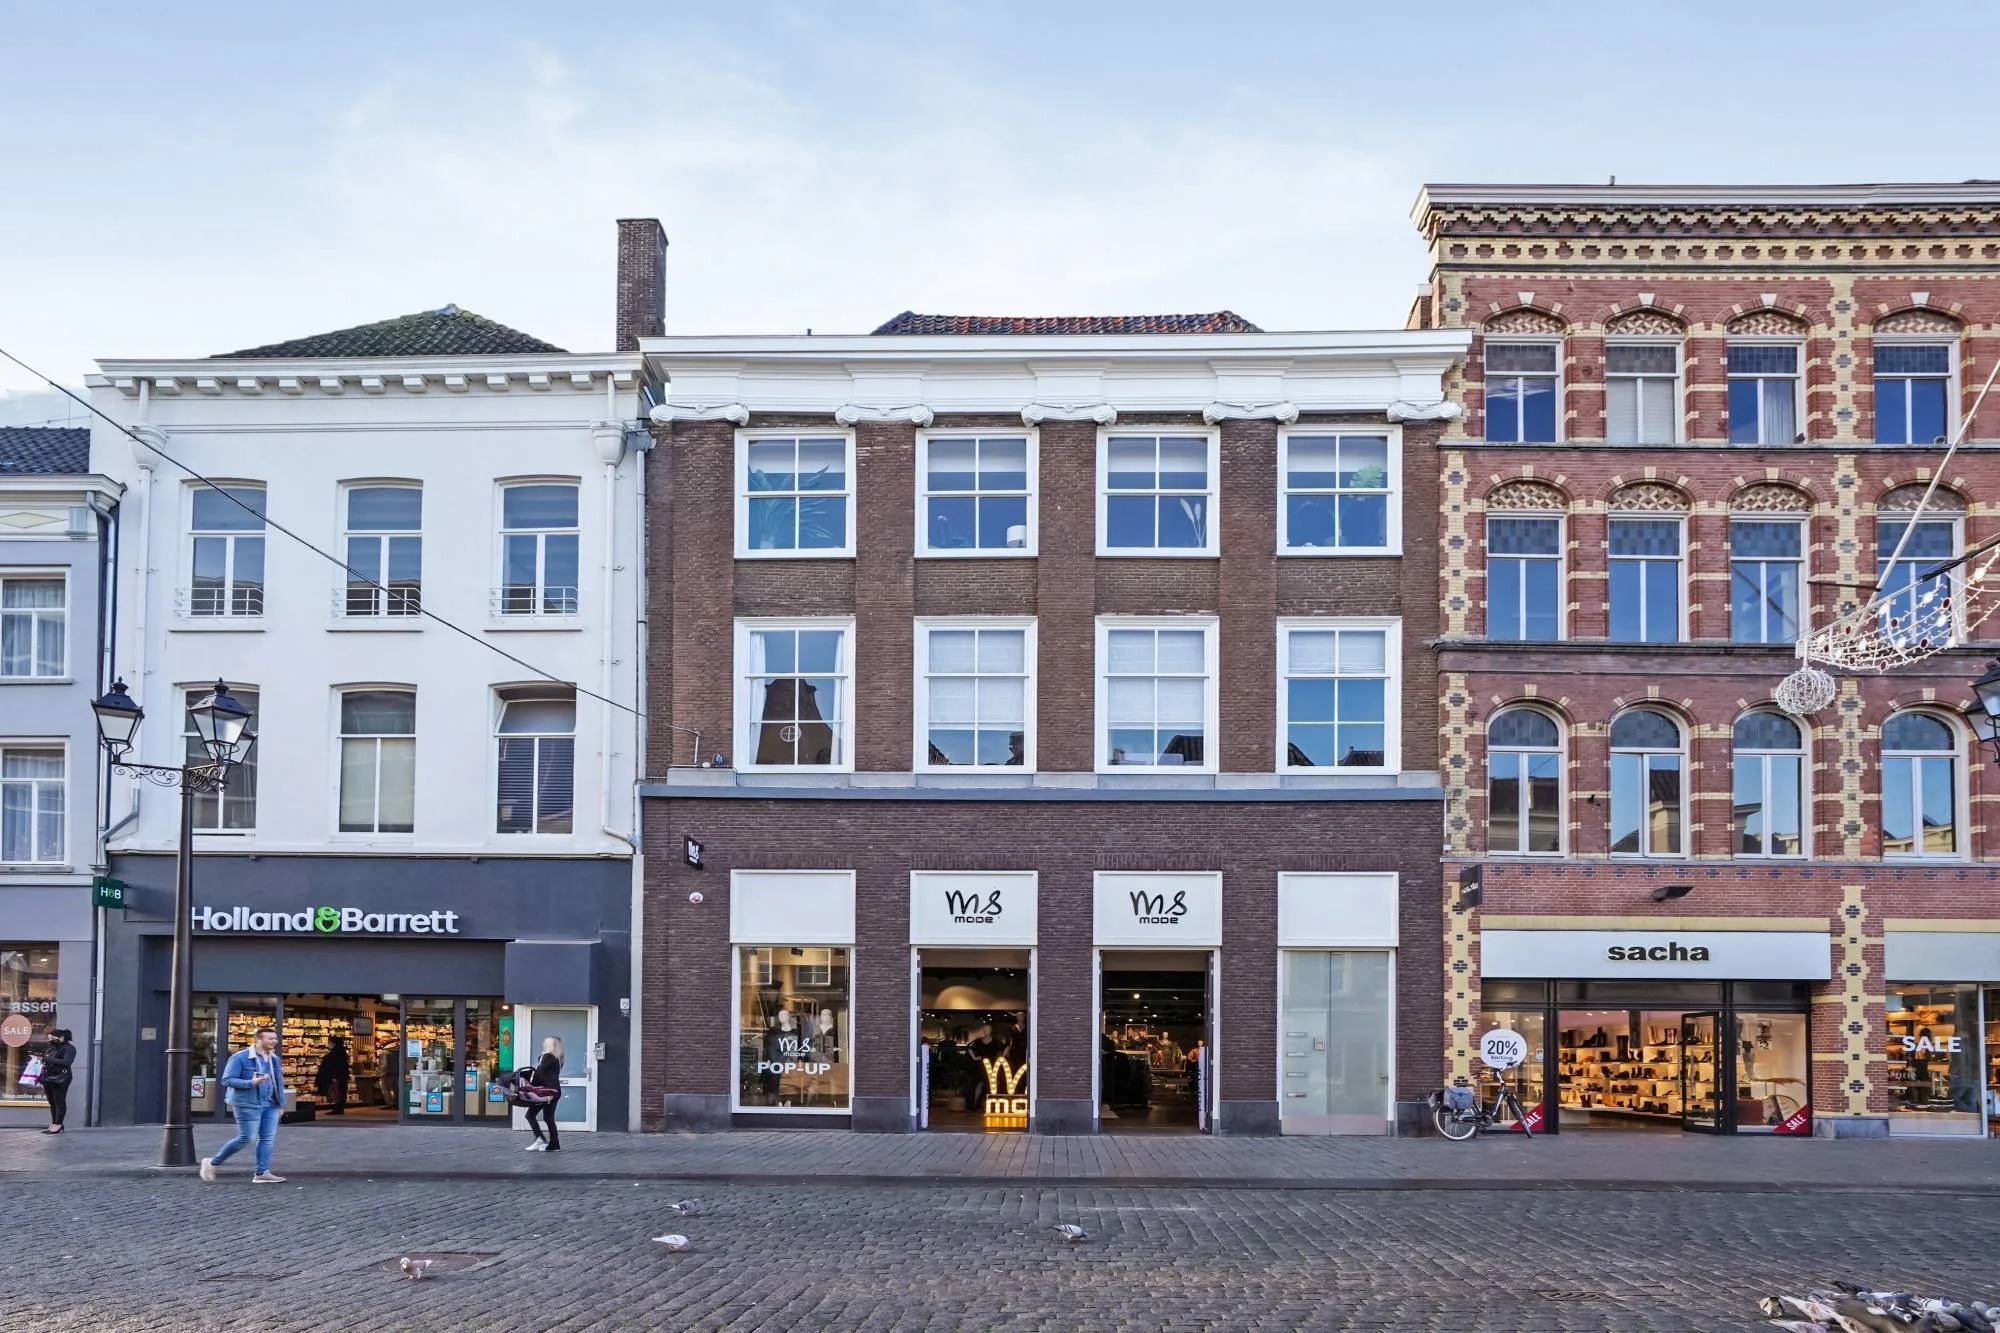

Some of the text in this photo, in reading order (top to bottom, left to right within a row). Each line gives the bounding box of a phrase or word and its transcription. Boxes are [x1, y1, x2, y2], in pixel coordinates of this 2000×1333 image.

[1607, 941, 1709, 961] sacha
[3, 1026, 29, 1035] SALE
[1487, 1040, 1518, 1056] 20%
[1902, 1035, 1962, 1053] SALE
[757, 1062, 831, 1075] POP-UP
[1786, 1114, 1806, 1130] SALE
